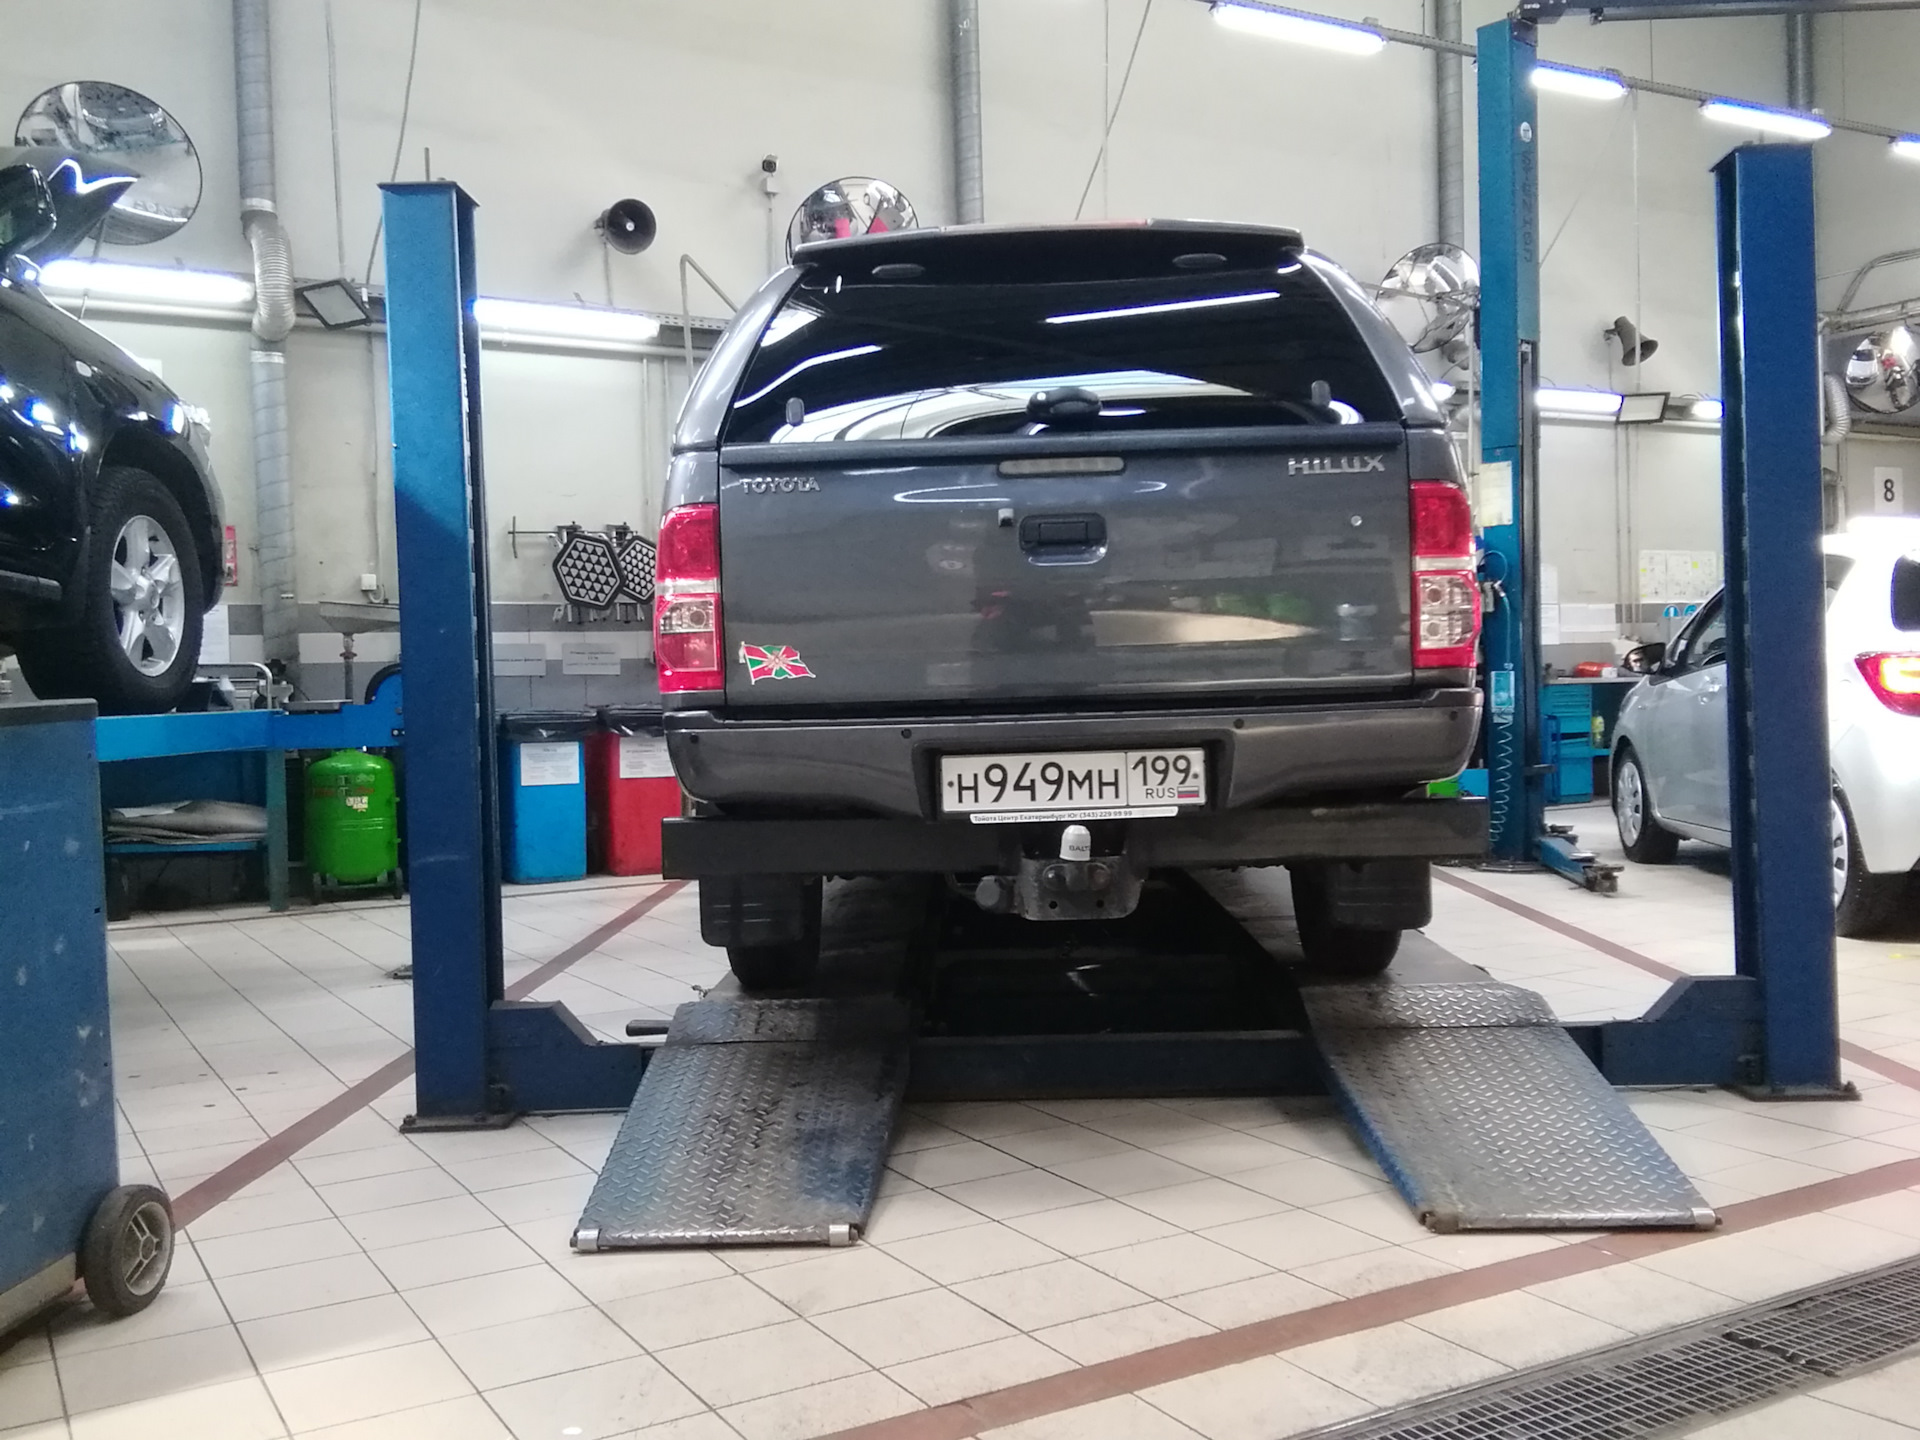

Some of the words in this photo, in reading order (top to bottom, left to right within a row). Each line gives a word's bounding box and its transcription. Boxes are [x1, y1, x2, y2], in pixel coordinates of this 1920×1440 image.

[1288, 455, 1385, 475] HILUX
[739, 477, 821, 493] TOYOTA
[1884, 478, 1895, 502] 8
[1131, 754, 1192, 787] 199
[1145, 787, 1176, 799] RUS
[998, 814, 1019, 822] Центр
[1079, 811, 1098, 819] (343)
